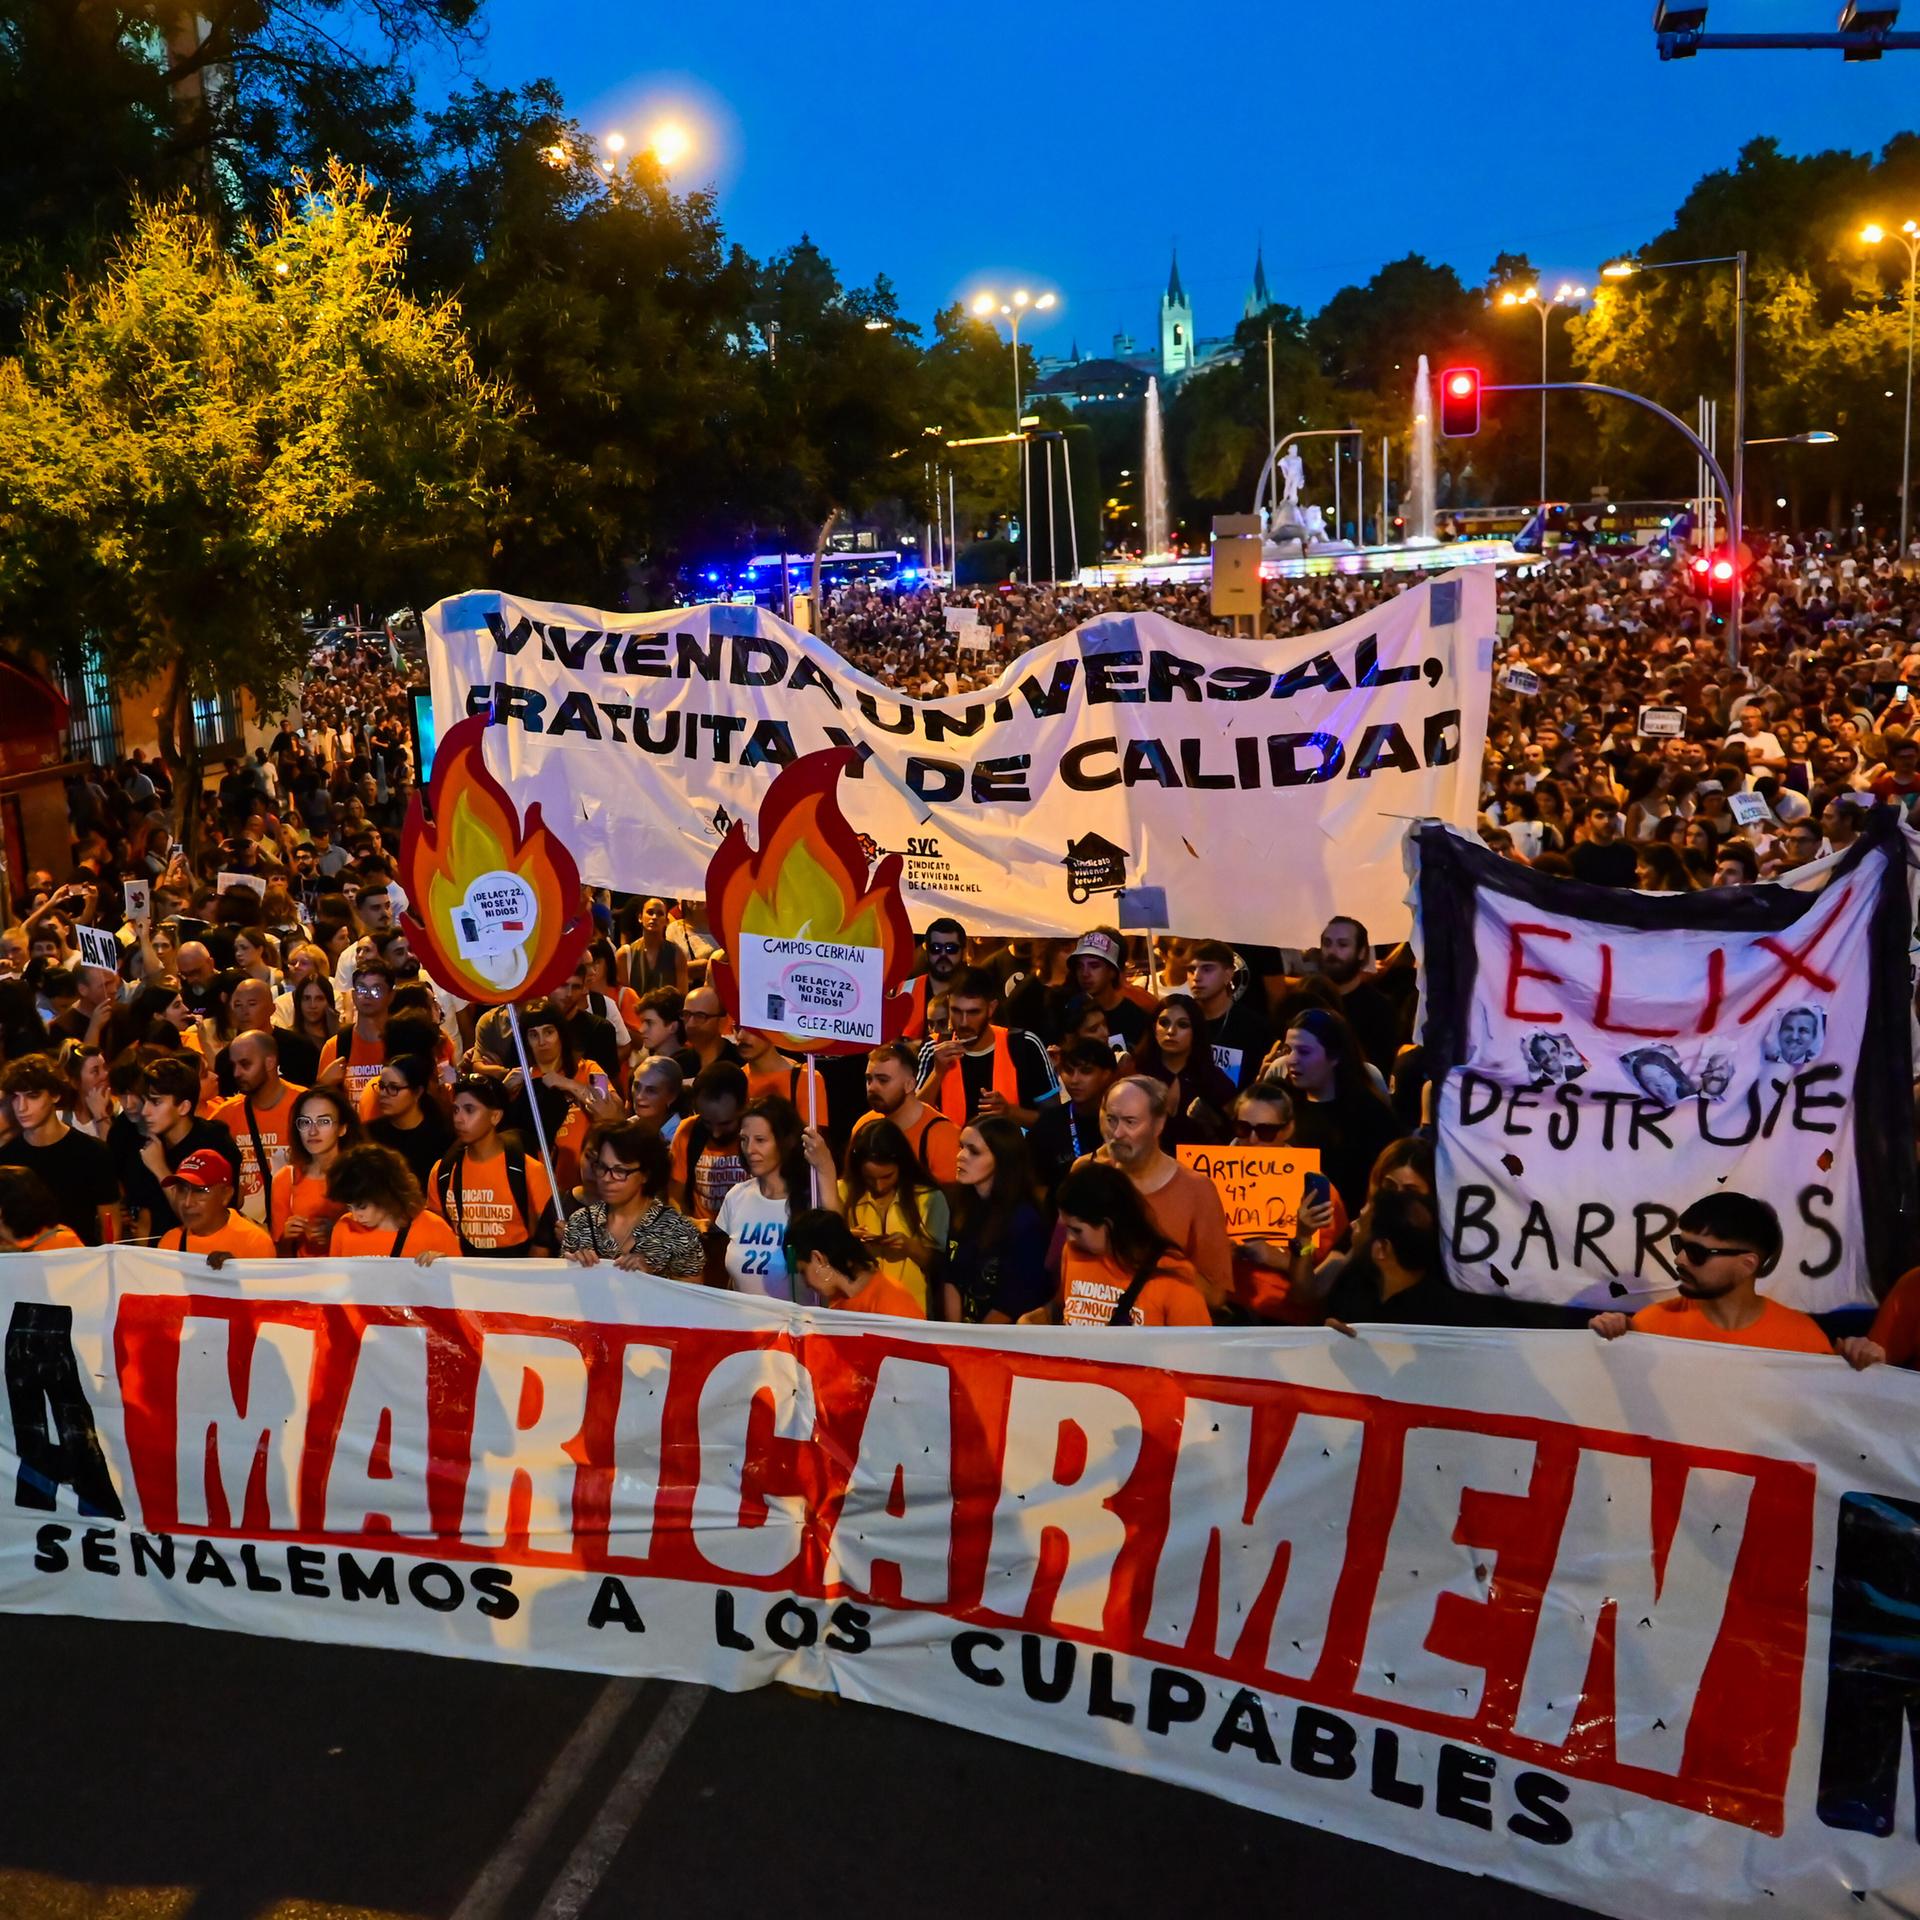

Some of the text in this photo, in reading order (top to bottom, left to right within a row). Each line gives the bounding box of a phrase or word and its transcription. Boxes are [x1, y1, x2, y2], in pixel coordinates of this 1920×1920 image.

[483, 611, 1444, 742] VIVIENDA UNIVERSAL,
[465, 681, 799, 769] GRATUITA
[905, 753, 1032, 804] DE
[1059, 709, 1461, 792] CALIDAD
[907, 837, 939, 855] SVC
[908, 860, 951, 870] SINDICATO
[908, 871, 960, 881] DE VIVIENDA
[487, 890, 508, 899] LACY
[908, 881, 983, 892] DE CARABANCHEL
[481, 901, 493, 909] NO
[485, 907, 518, 918] NI DIOS!
[100, 936, 116, 971] NO
[763, 938, 865, 963] CAMPOS CEBRIÁN
[1504, 886, 1852, 1037] ELIX
[798, 984, 844, 999] NO SE VA
[810, 976, 837, 988] LACY
[800, 993, 842, 1008] NI DIOS!
[797, 1015, 874, 1038] GLEZ-RUANO
[1460, 1063, 1846, 1151] DESTRUYE
[447, 1189, 494, 1202] SIDICATO
[1452, 1184, 1842, 1281] BARRS
[741, 1249, 772, 1275] 22
[176, 1314, 1757, 1779] MARICARMEN
[587, 1576, 646, 1633] A
[715, 1589, 871, 1655] LOS
[951, 1629, 1575, 1846] CULPABLES
